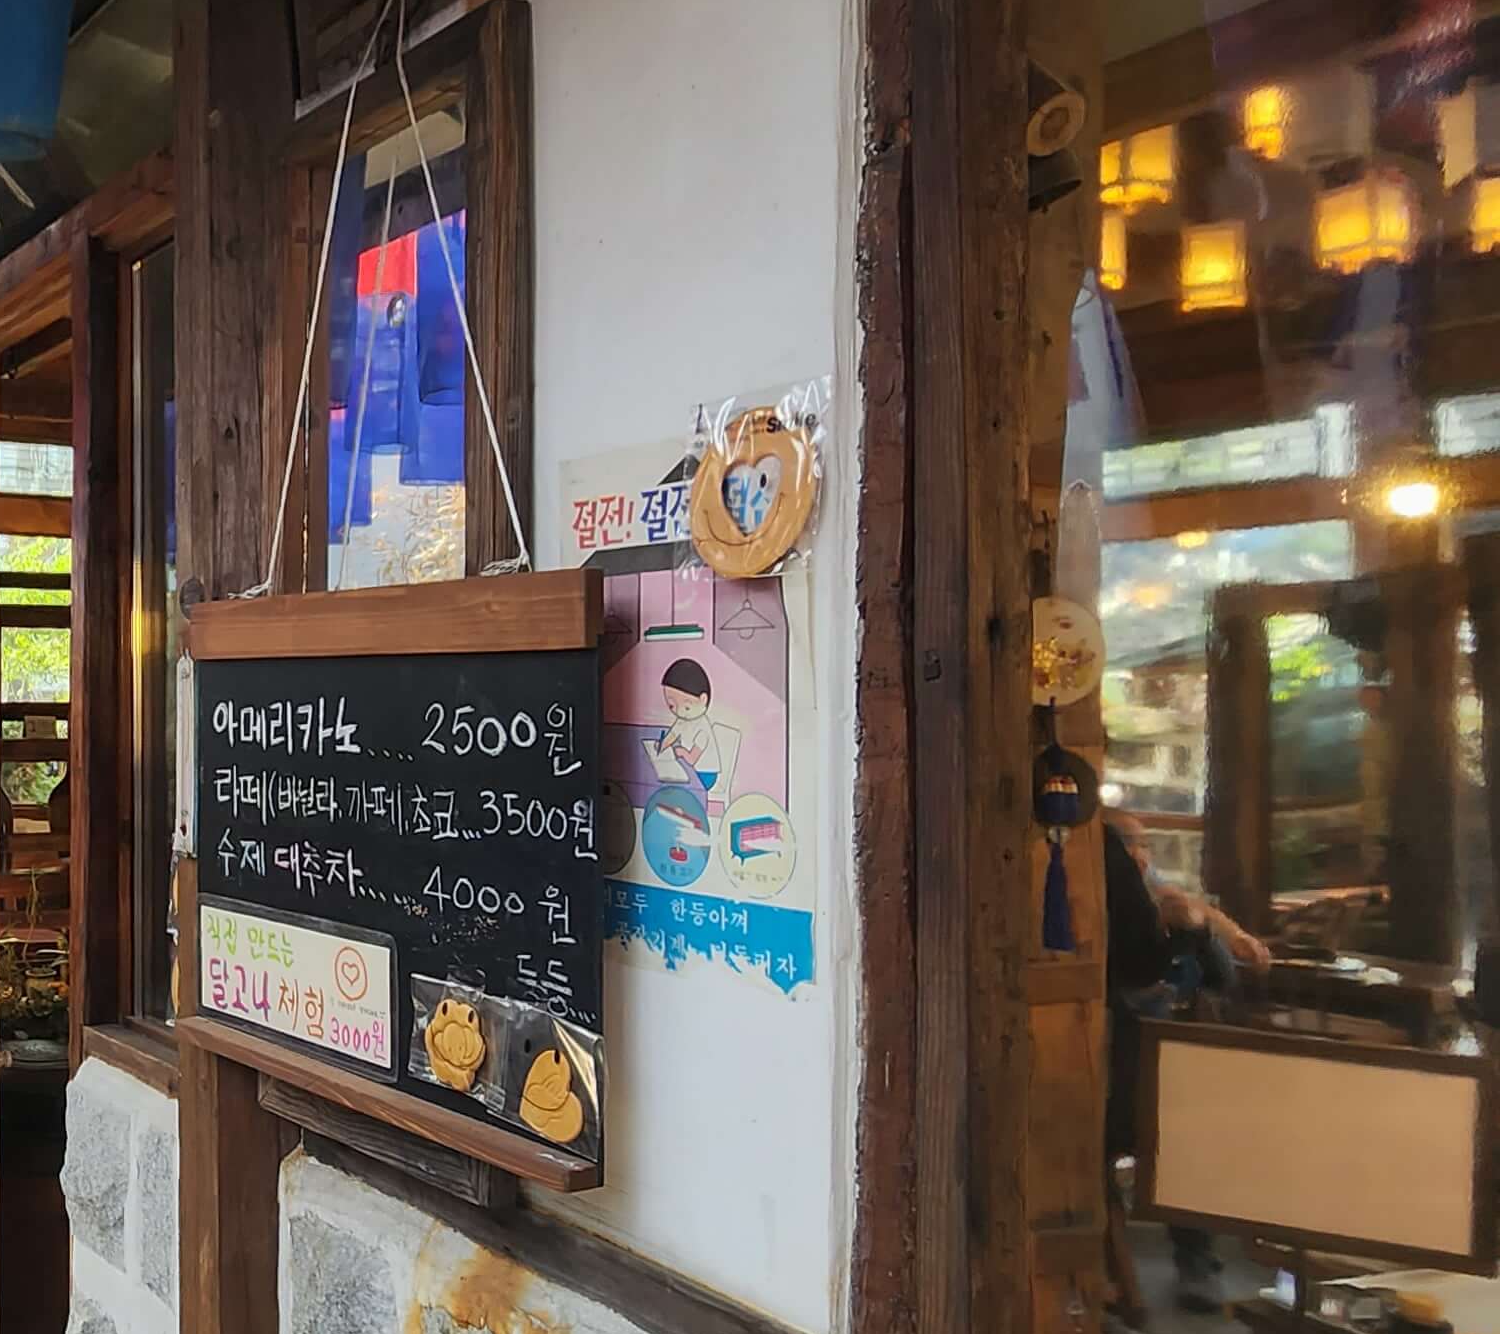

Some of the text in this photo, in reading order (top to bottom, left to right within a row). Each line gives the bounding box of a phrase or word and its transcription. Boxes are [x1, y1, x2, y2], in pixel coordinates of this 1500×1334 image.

[572, 493, 636, 549] 절전!
[217, 827, 266, 877] 수제
[247, 926, 295, 968] 만드는
[209, 957, 325, 1039] 달고나 체험
[329, 1016, 387, 1061] 3000원
